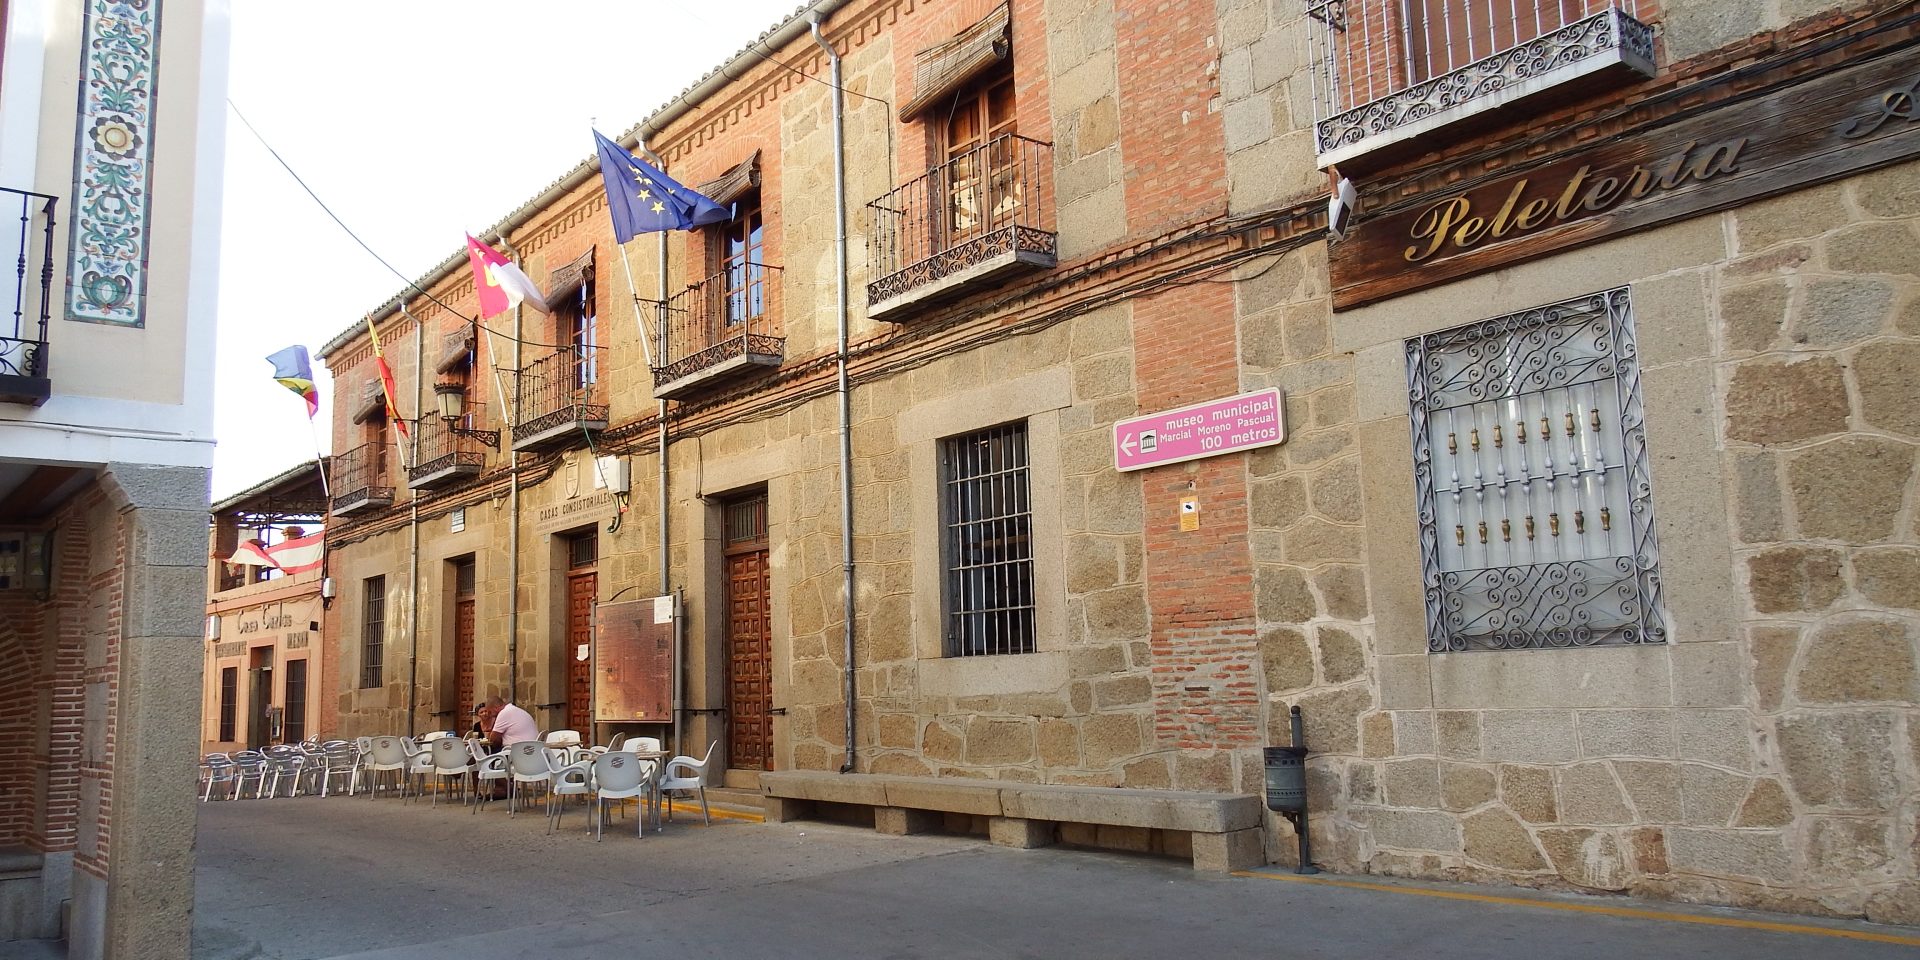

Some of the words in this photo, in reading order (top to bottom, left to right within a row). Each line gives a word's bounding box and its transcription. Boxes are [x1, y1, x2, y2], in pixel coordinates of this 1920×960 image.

[1160, 429, 1192, 444] Marcial
[1197, 423, 1231, 436] Moreno
[1237, 412, 1275, 428] Pascual
[1166, 414, 1204, 431] museo
[1212, 397, 1274, 421] municipal
[1200, 435, 1222, 450] 100
[1231, 427, 1276, 445] metros
[540, 506, 559, 521] CASAS
[562, 491, 612, 515] CONSISTORIALES
